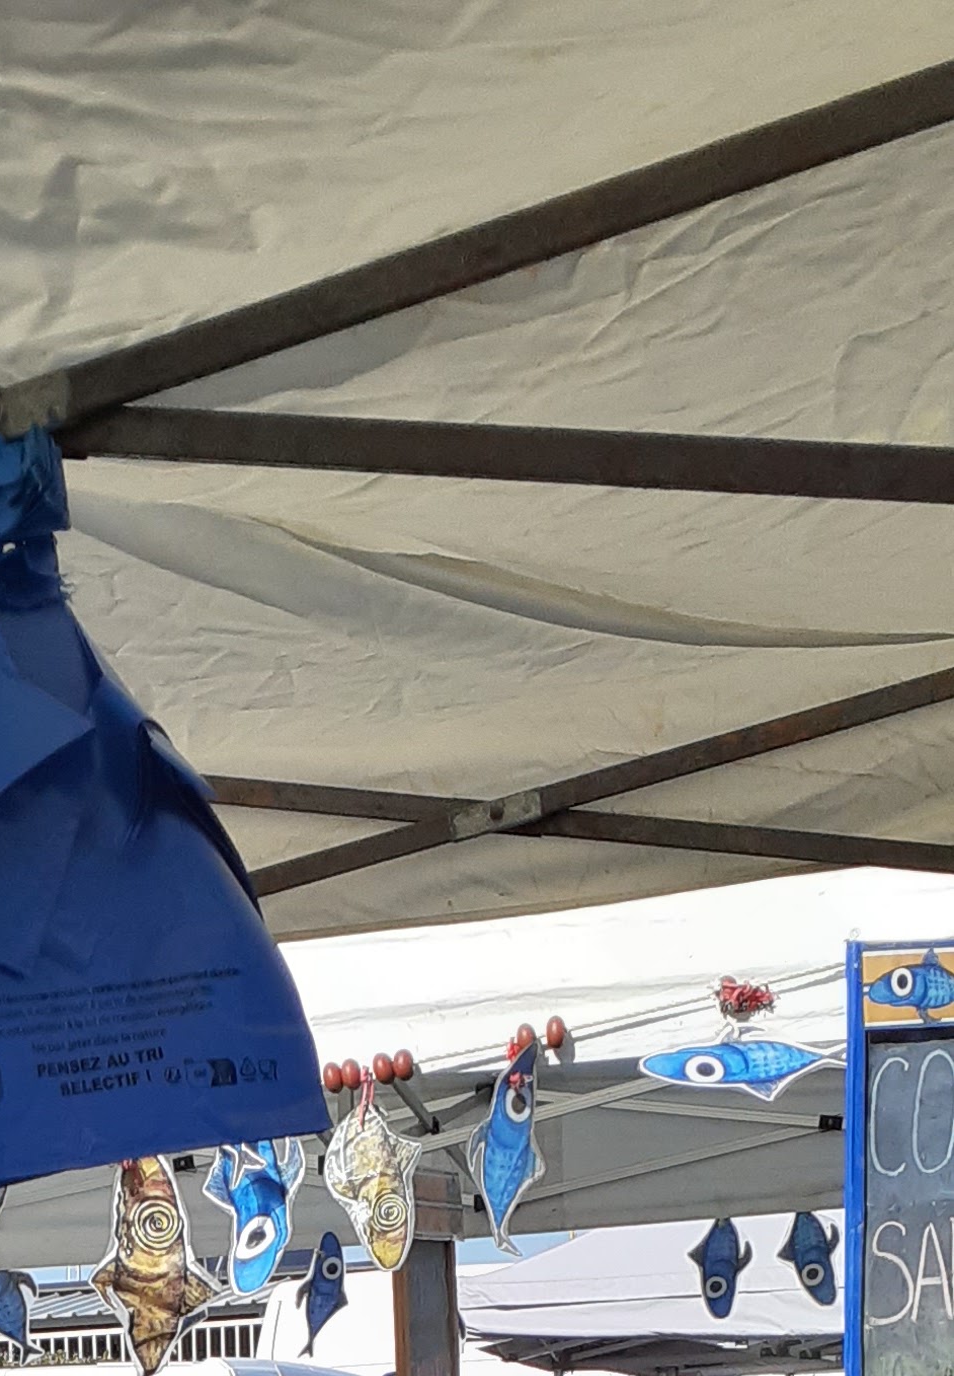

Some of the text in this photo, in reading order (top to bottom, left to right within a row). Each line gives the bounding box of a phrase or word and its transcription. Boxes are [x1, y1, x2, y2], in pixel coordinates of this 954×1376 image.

[36, 1055, 100, 1077] PENSEZ
[106, 1051, 130, 1067] AU
[135, 1046, 164, 1063] TRI
[59, 1071, 140, 1096] SELECTIF
[870, 1217, 954, 1327] SA
